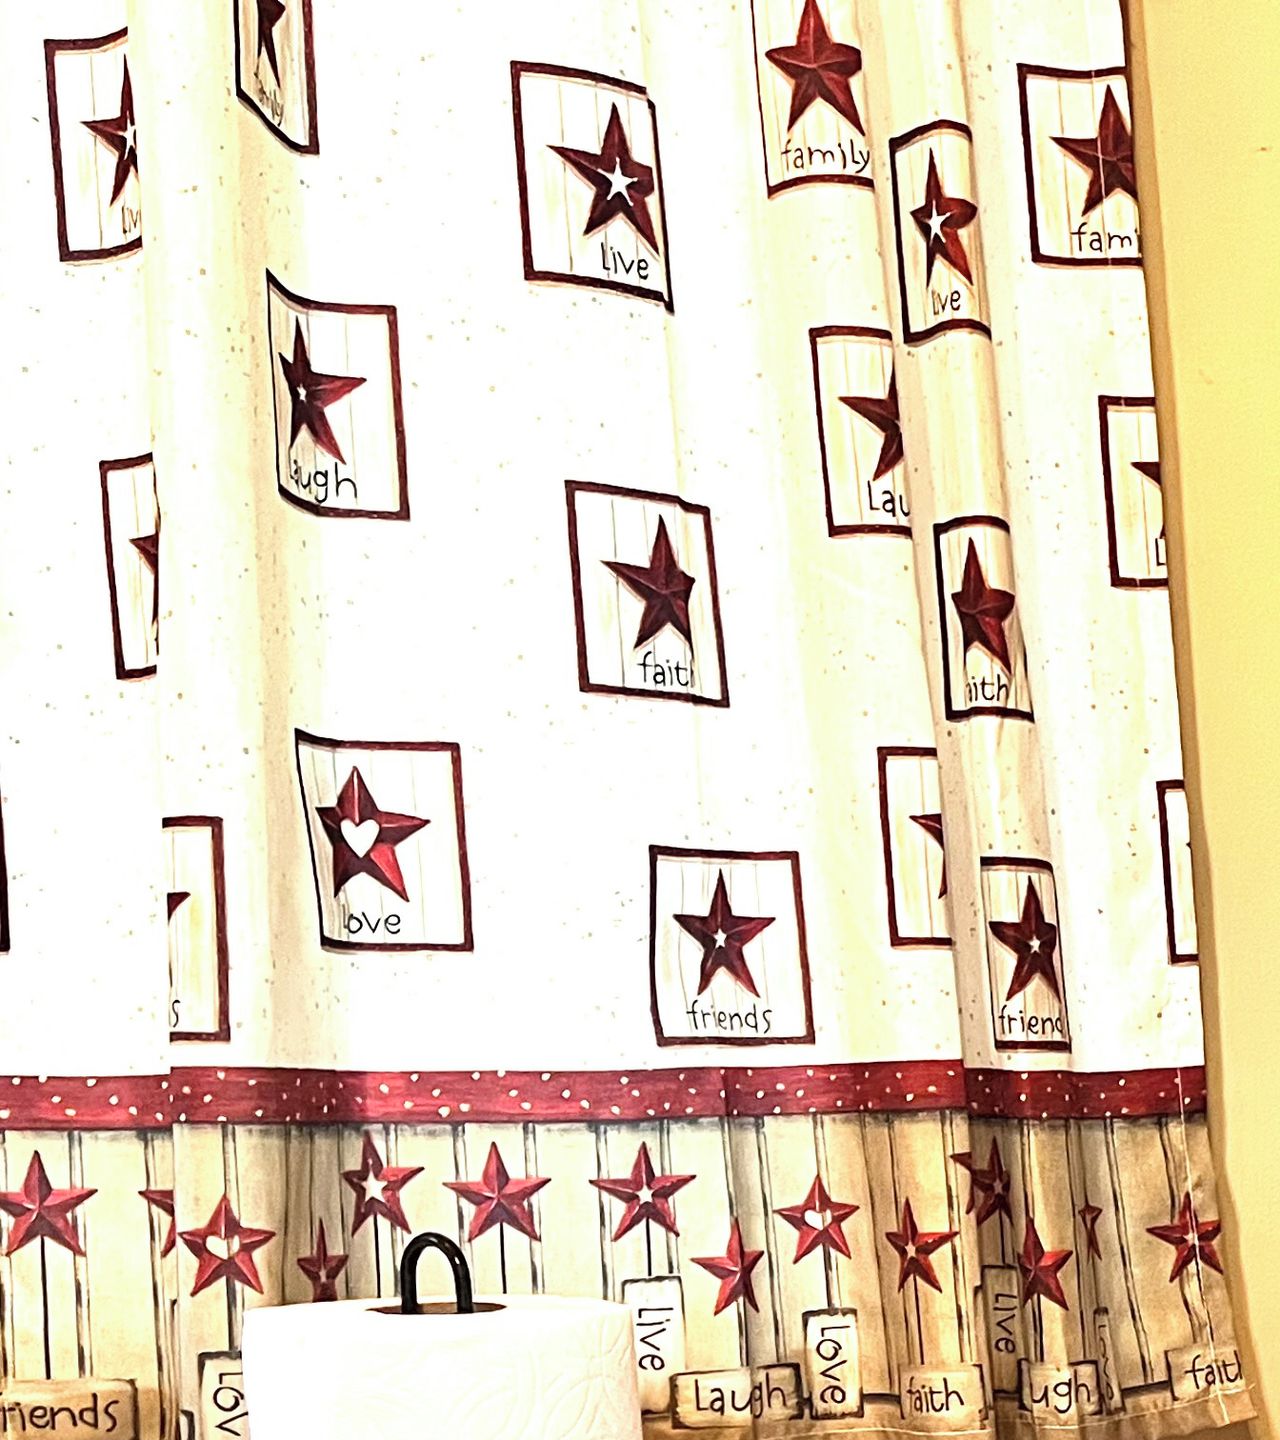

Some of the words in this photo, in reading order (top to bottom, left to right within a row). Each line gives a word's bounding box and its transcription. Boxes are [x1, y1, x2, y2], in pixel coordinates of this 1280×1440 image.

[781, 138, 870, 174] family
[686, 999, 773, 1035] friends
[0, 1391, 120, 1433] riends
[694, 1371, 788, 1420] Laugh
[906, 1374, 966, 1414] faith
